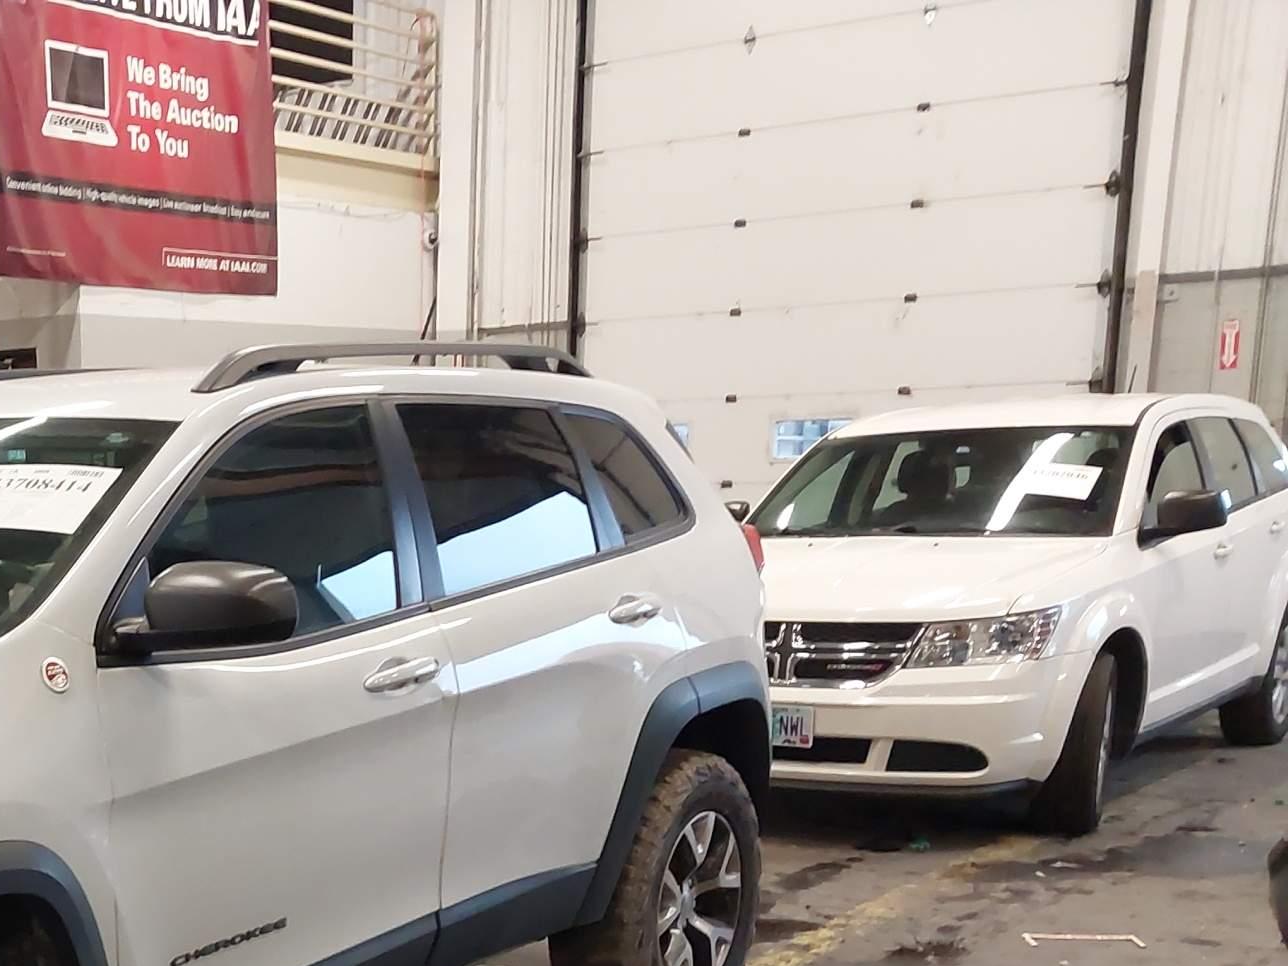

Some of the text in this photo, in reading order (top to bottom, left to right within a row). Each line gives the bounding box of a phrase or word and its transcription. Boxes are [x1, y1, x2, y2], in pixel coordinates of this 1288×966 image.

[126, 55, 209, 102] We Bring
[126, 90, 239, 134] The Auction
[126, 124, 189, 158] To You
[166, 254, 195, 269] LEARN
[196, 256, 218, 271] MORE
[219, 258, 230, 272] AT
